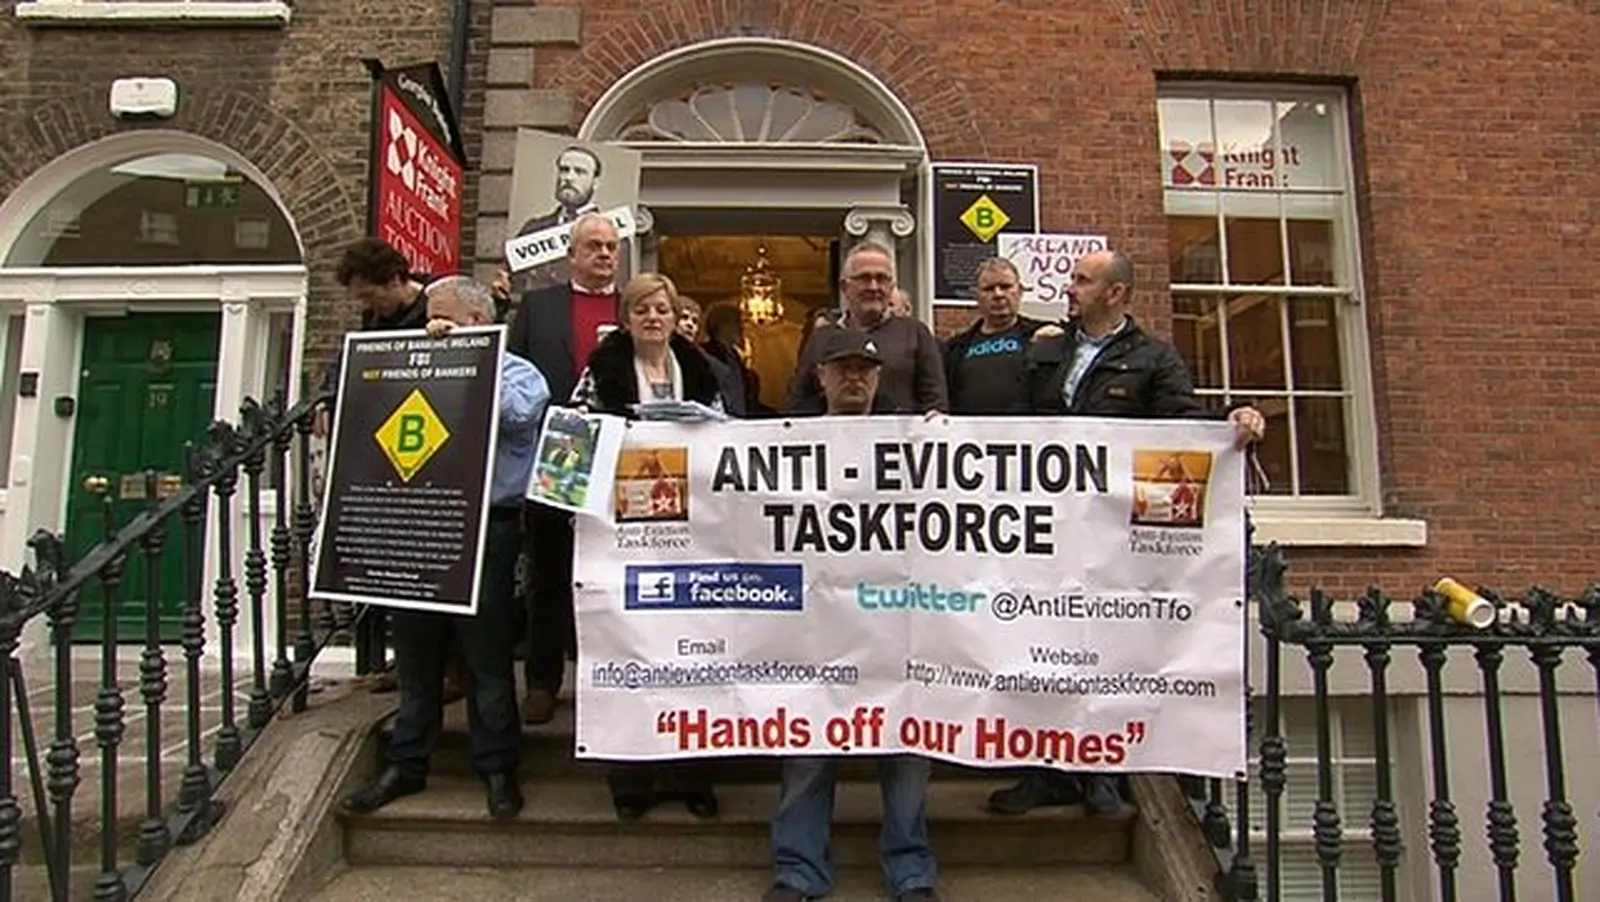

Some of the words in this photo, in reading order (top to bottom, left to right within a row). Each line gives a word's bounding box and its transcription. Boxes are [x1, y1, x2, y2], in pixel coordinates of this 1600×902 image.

[386, 190, 452, 264] AUCTION
[976, 207, 994, 228] B
[515, 237, 557, 260] VOTE
[1030, 256, 1079, 274] NO
[398, 415, 425, 452] B
[712, 444, 827, 492] ANTI
[875, 441, 1107, 493] EVICTION
[764, 501, 1054, 554] TASKFORCE
[689, 571, 719, 582] Find
[723, 572, 739, 583] us
[857, 583, 987, 612] twitter
[991, 592, 1192, 622] @AntiEvictionTfo
[677, 639, 726, 656] Email
[1030, 647, 1099, 665] Website
[826, 706, 885, 748] off
[900, 717, 962, 753] our
